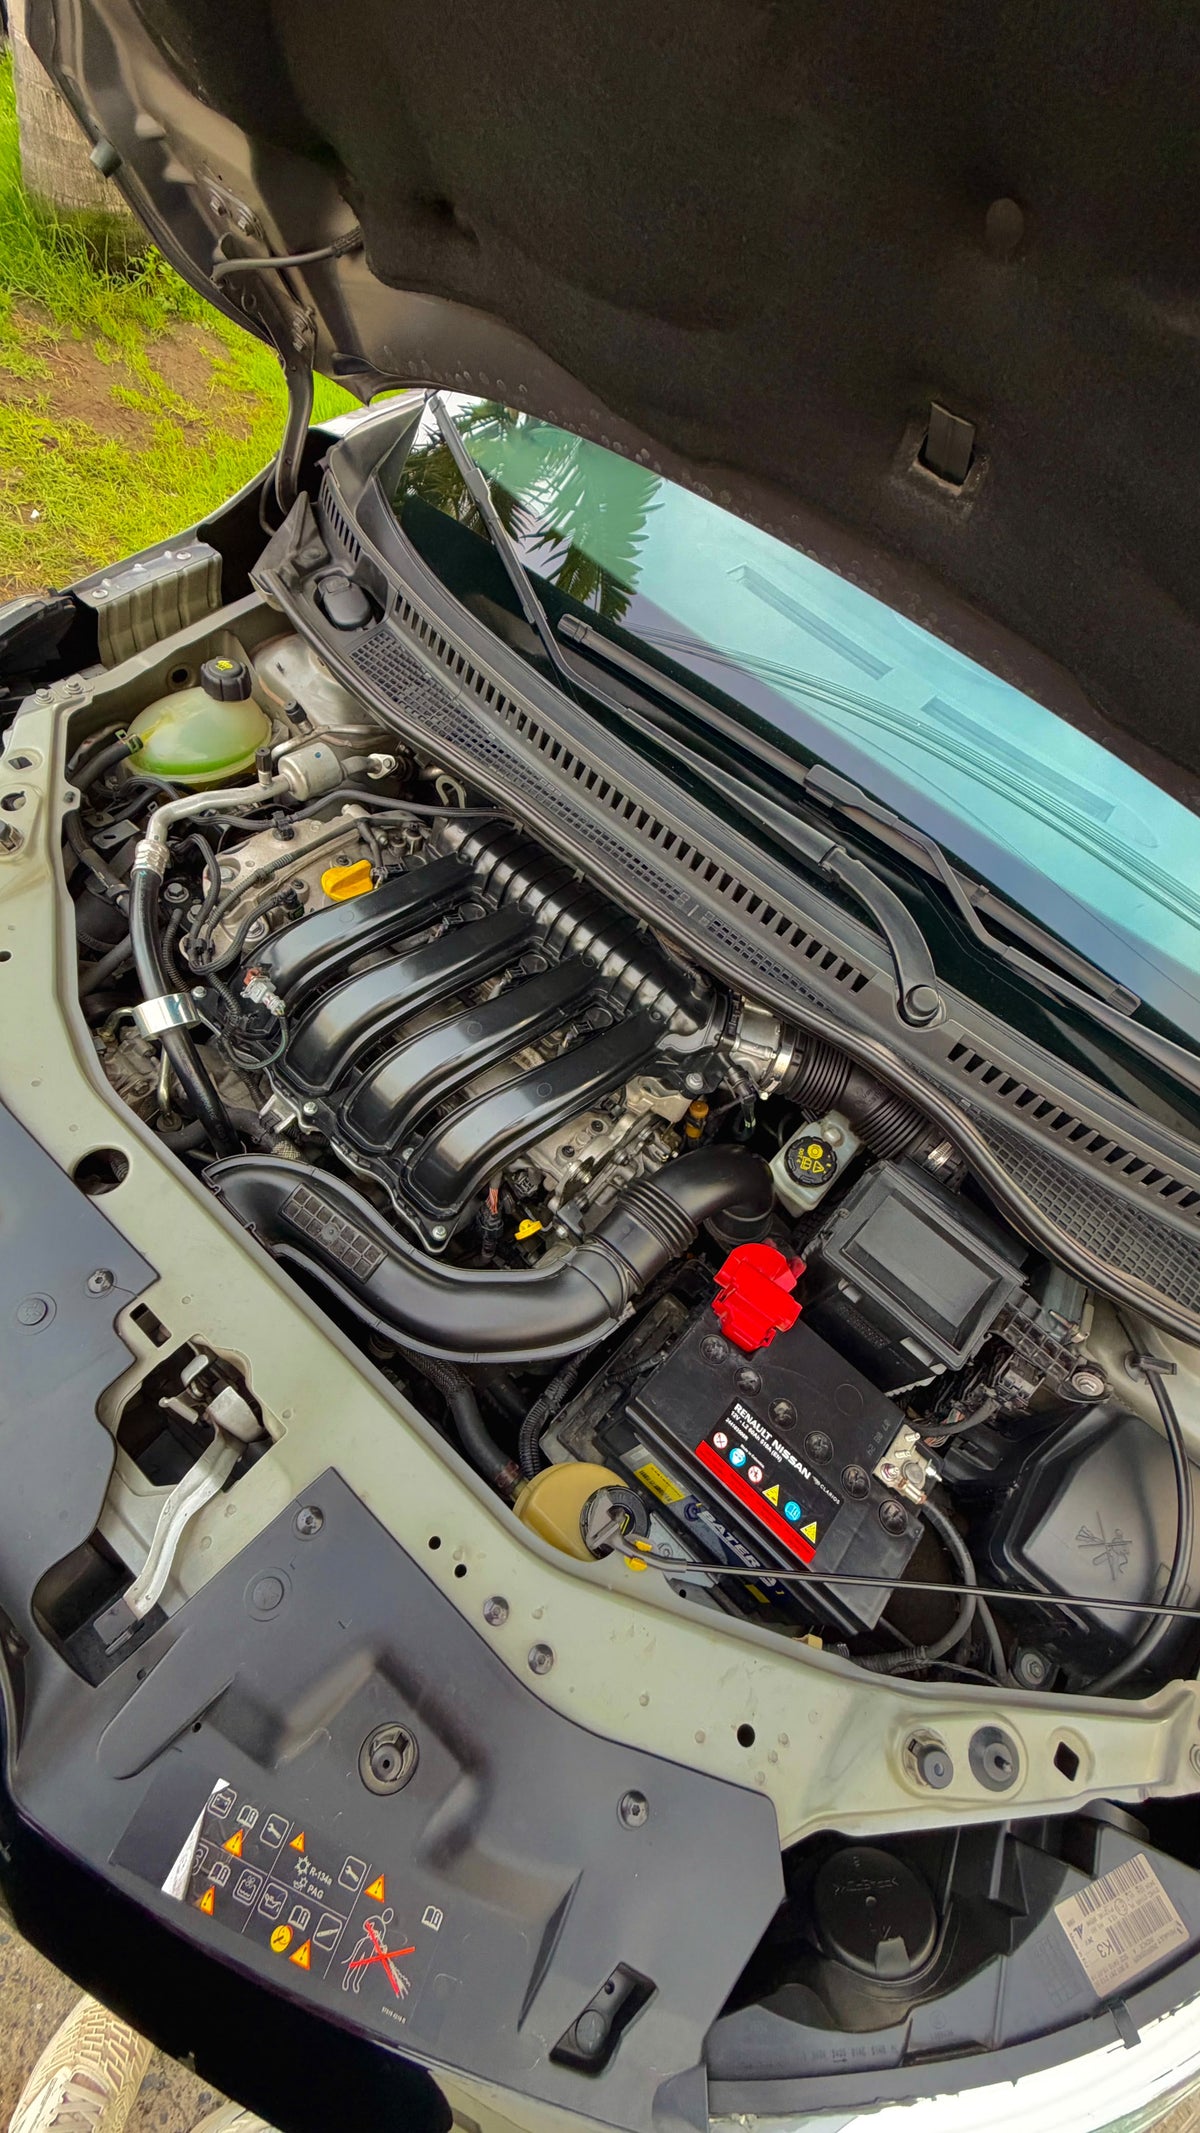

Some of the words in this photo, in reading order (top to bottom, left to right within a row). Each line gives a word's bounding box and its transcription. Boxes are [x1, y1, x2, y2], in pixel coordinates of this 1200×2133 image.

[731, 1410, 740, 1420] 12V
[741, 1421, 749, 1430] L2
[734, 1403, 772, 1440] RENAULT
[772, 1439, 811, 1479] NISSAN
[820, 1484, 840, 1504] CLARIOS
[309, 1866, 332, 1886] R-134a
[307, 1884, 324, 1899] PAG
[1096, 1938, 1114, 1958] K3
